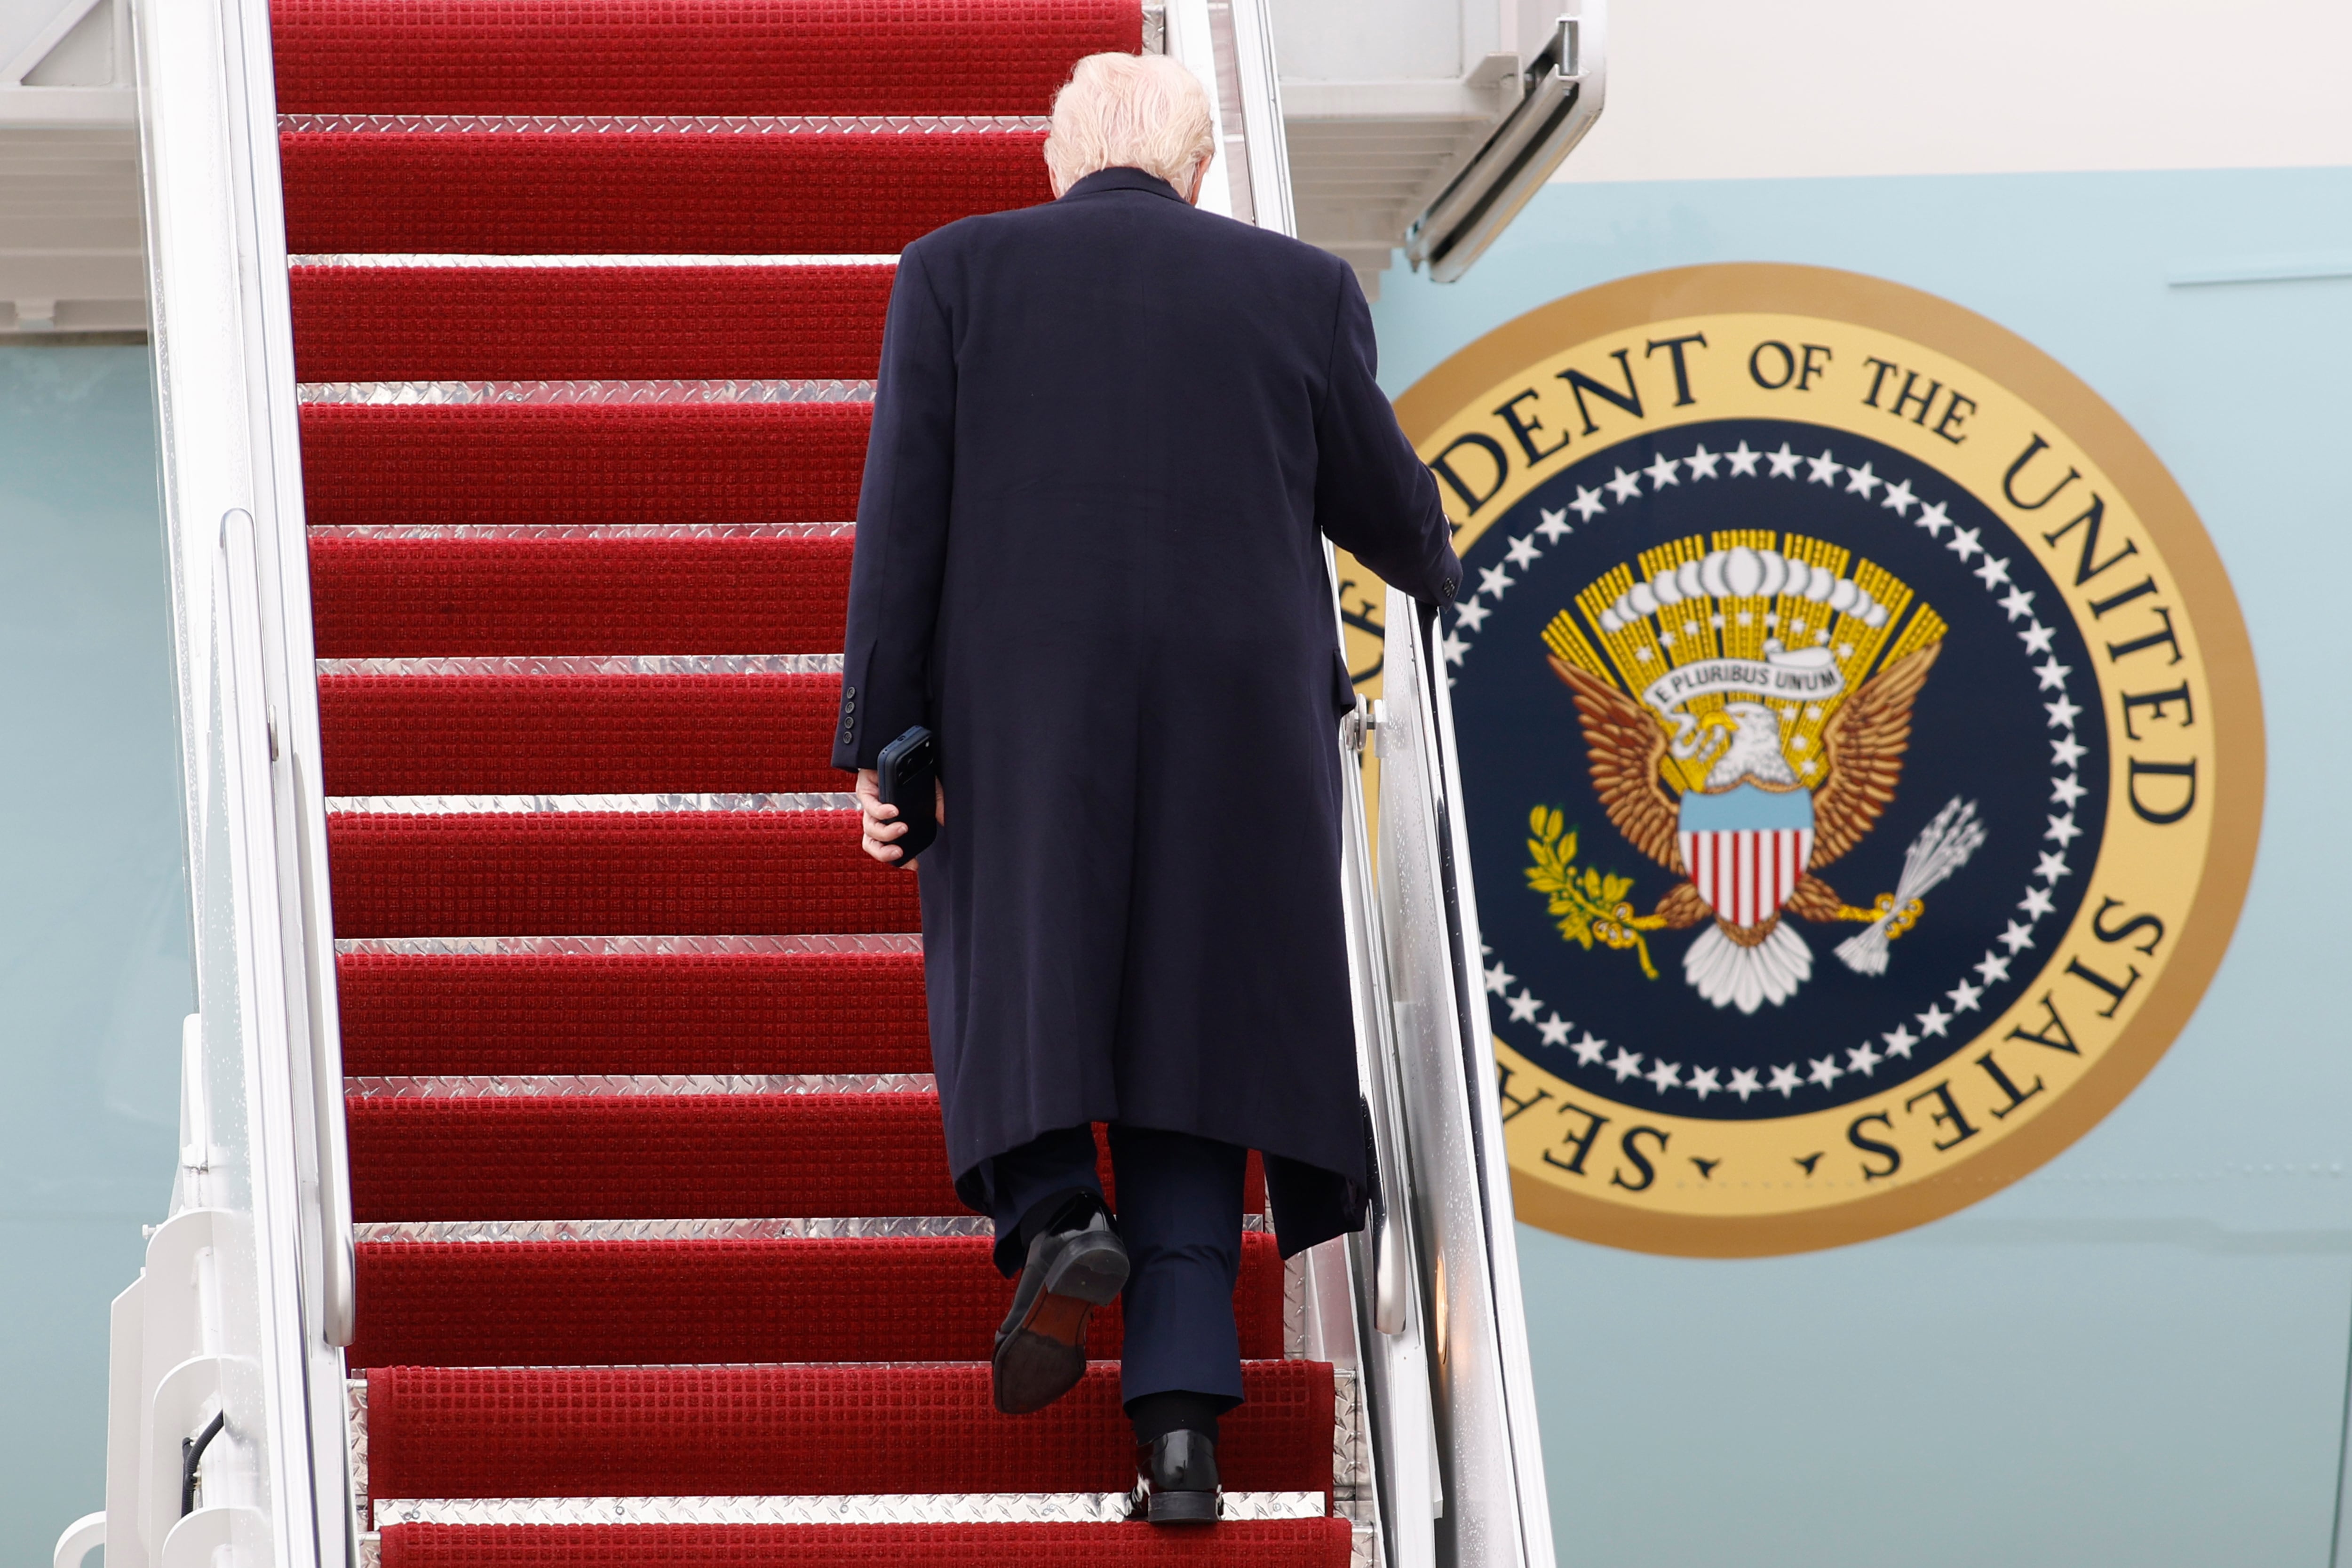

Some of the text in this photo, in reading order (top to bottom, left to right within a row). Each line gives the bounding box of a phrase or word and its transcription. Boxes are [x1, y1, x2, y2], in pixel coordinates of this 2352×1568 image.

[1748, 339, 1834, 392] OF
[1862, 355, 1979, 446] THE
[1654, 665, 1838, 703] E PLURIBUS UNUM
[2001, 431, 2197, 827] UNITED
[1845, 895, 2165, 1181] STATES
[1497, 1061, 1671, 1192] SEA
